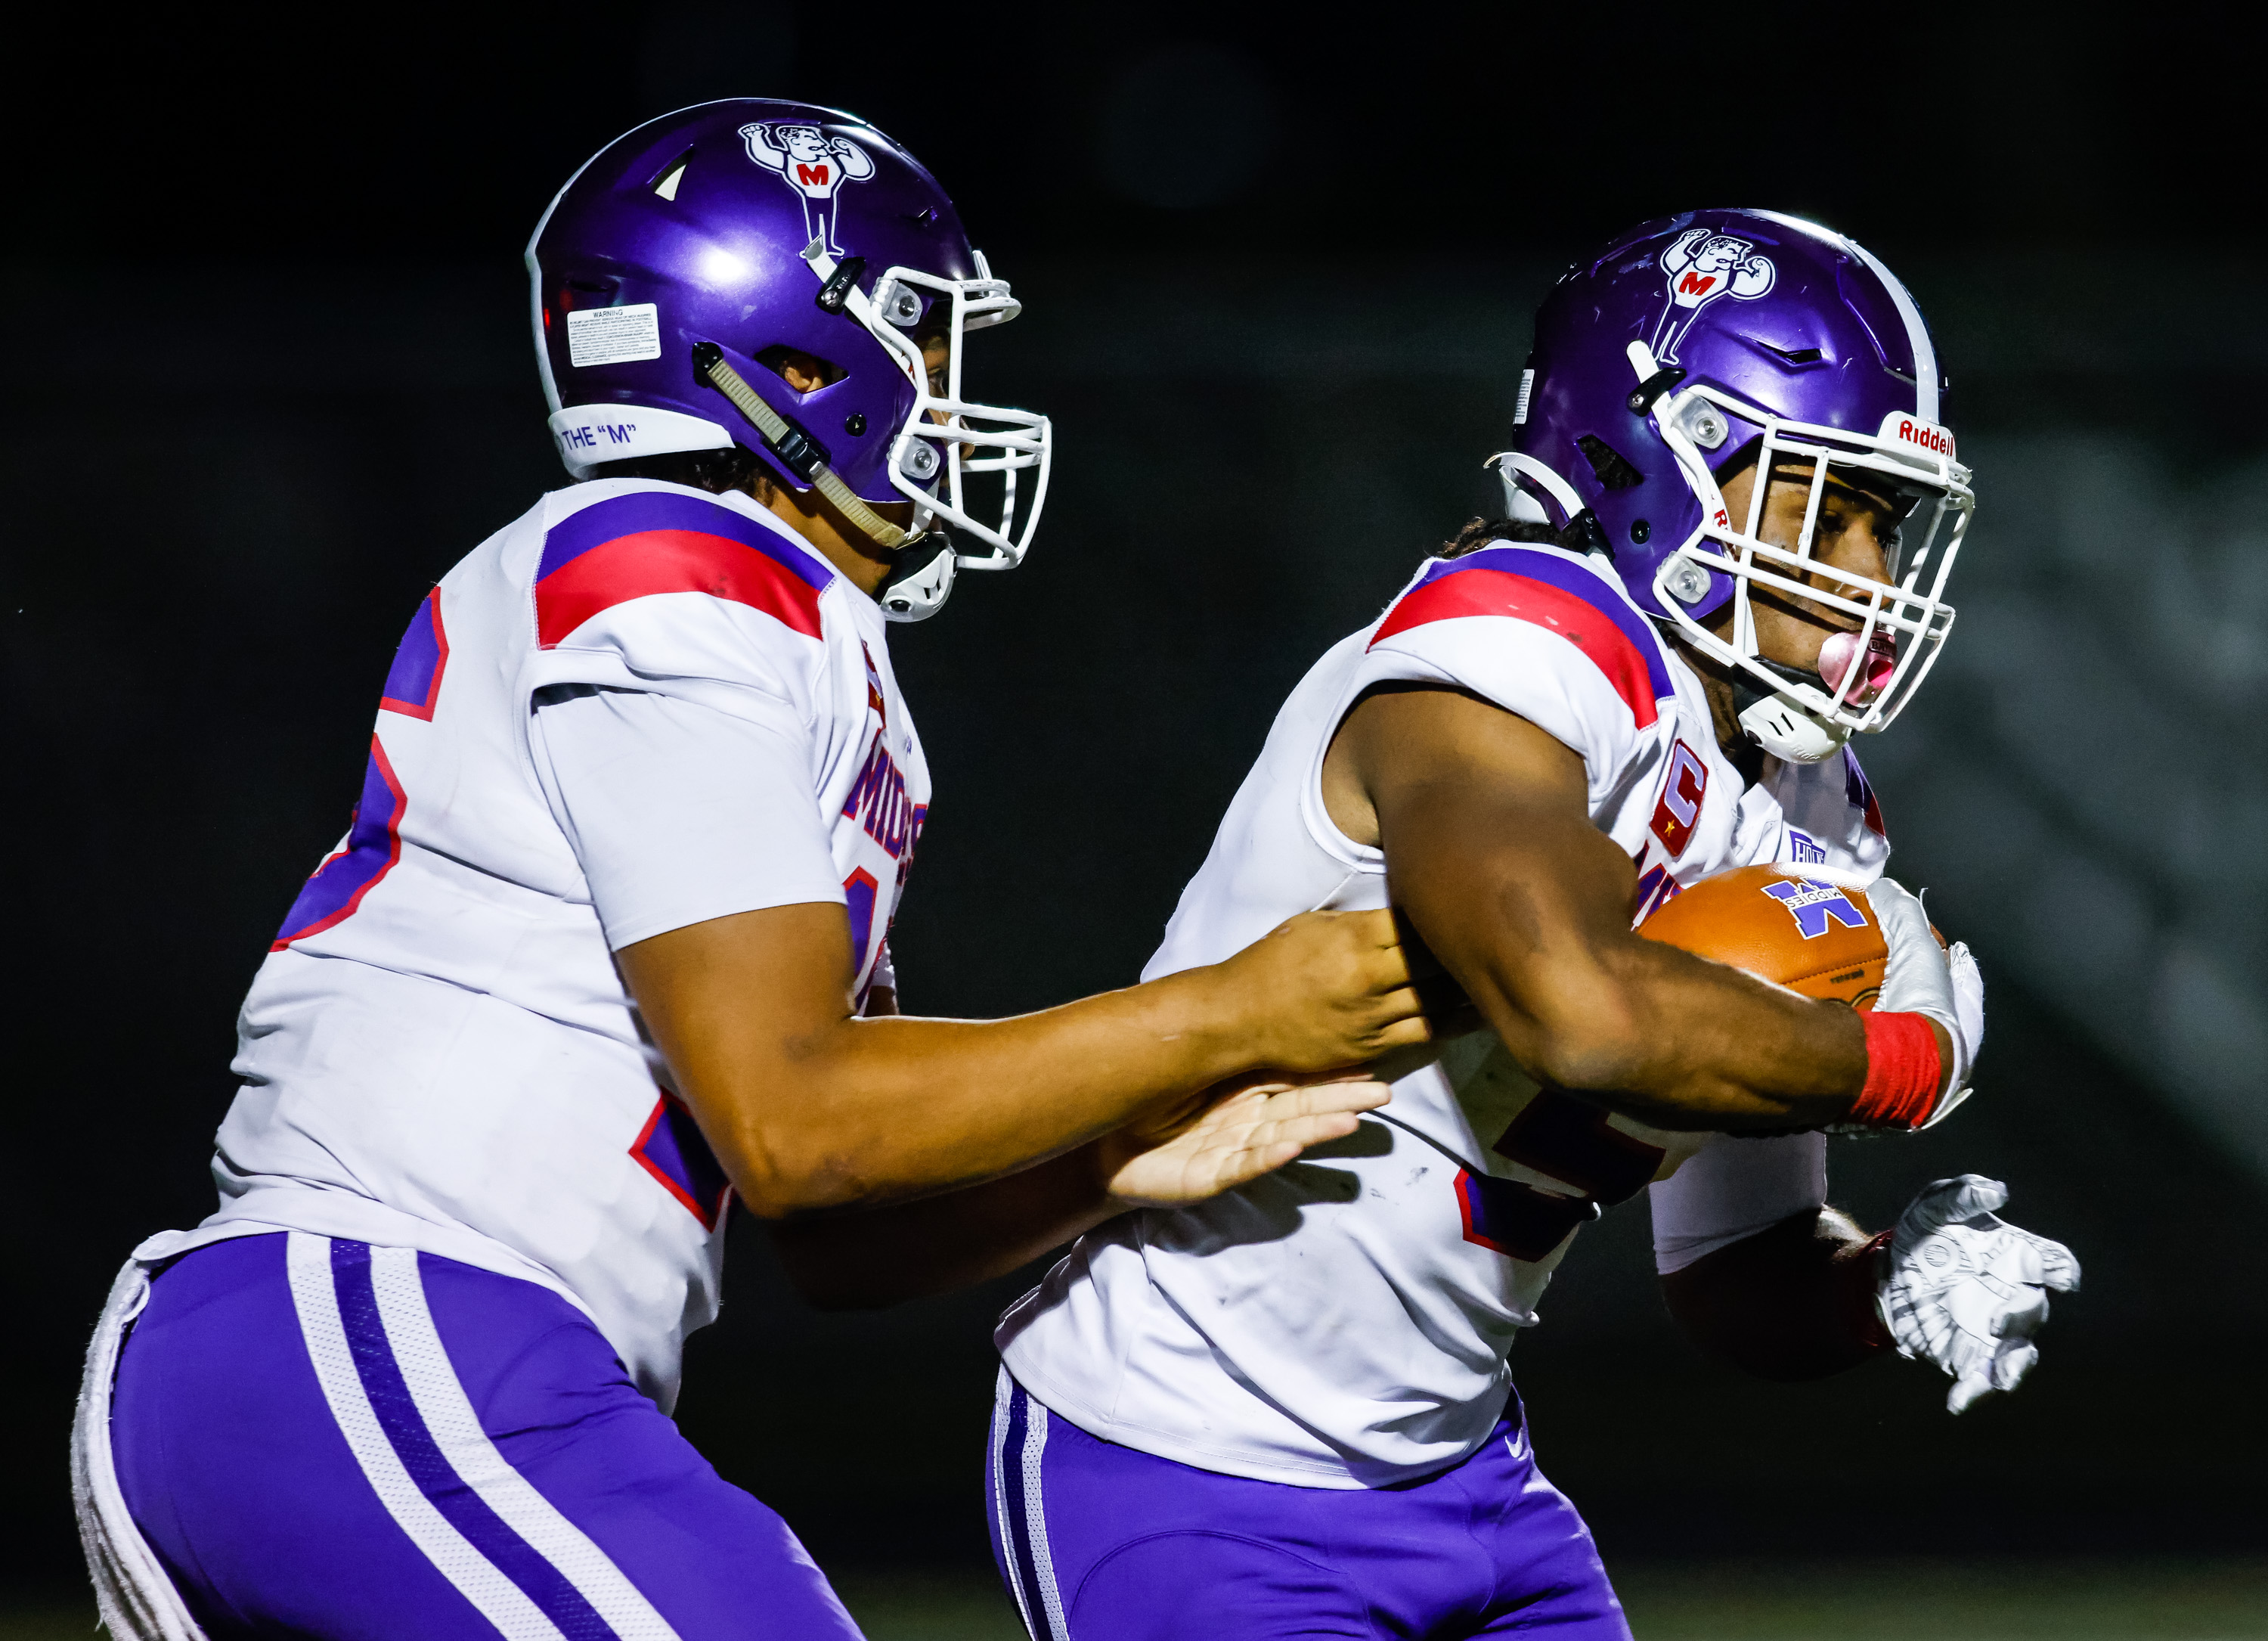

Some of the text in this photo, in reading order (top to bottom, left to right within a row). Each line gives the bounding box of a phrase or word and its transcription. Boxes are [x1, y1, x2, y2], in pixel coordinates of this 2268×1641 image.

[796, 163, 829, 186] M
[1678, 271, 1717, 296] M
[593, 309, 624, 318] WARNING
[562, 426, 596, 451] THE
[1899, 420, 1954, 457] Riddell
[1664, 743, 1704, 828] C
[1785, 889, 1842, 907] MIDDIES
